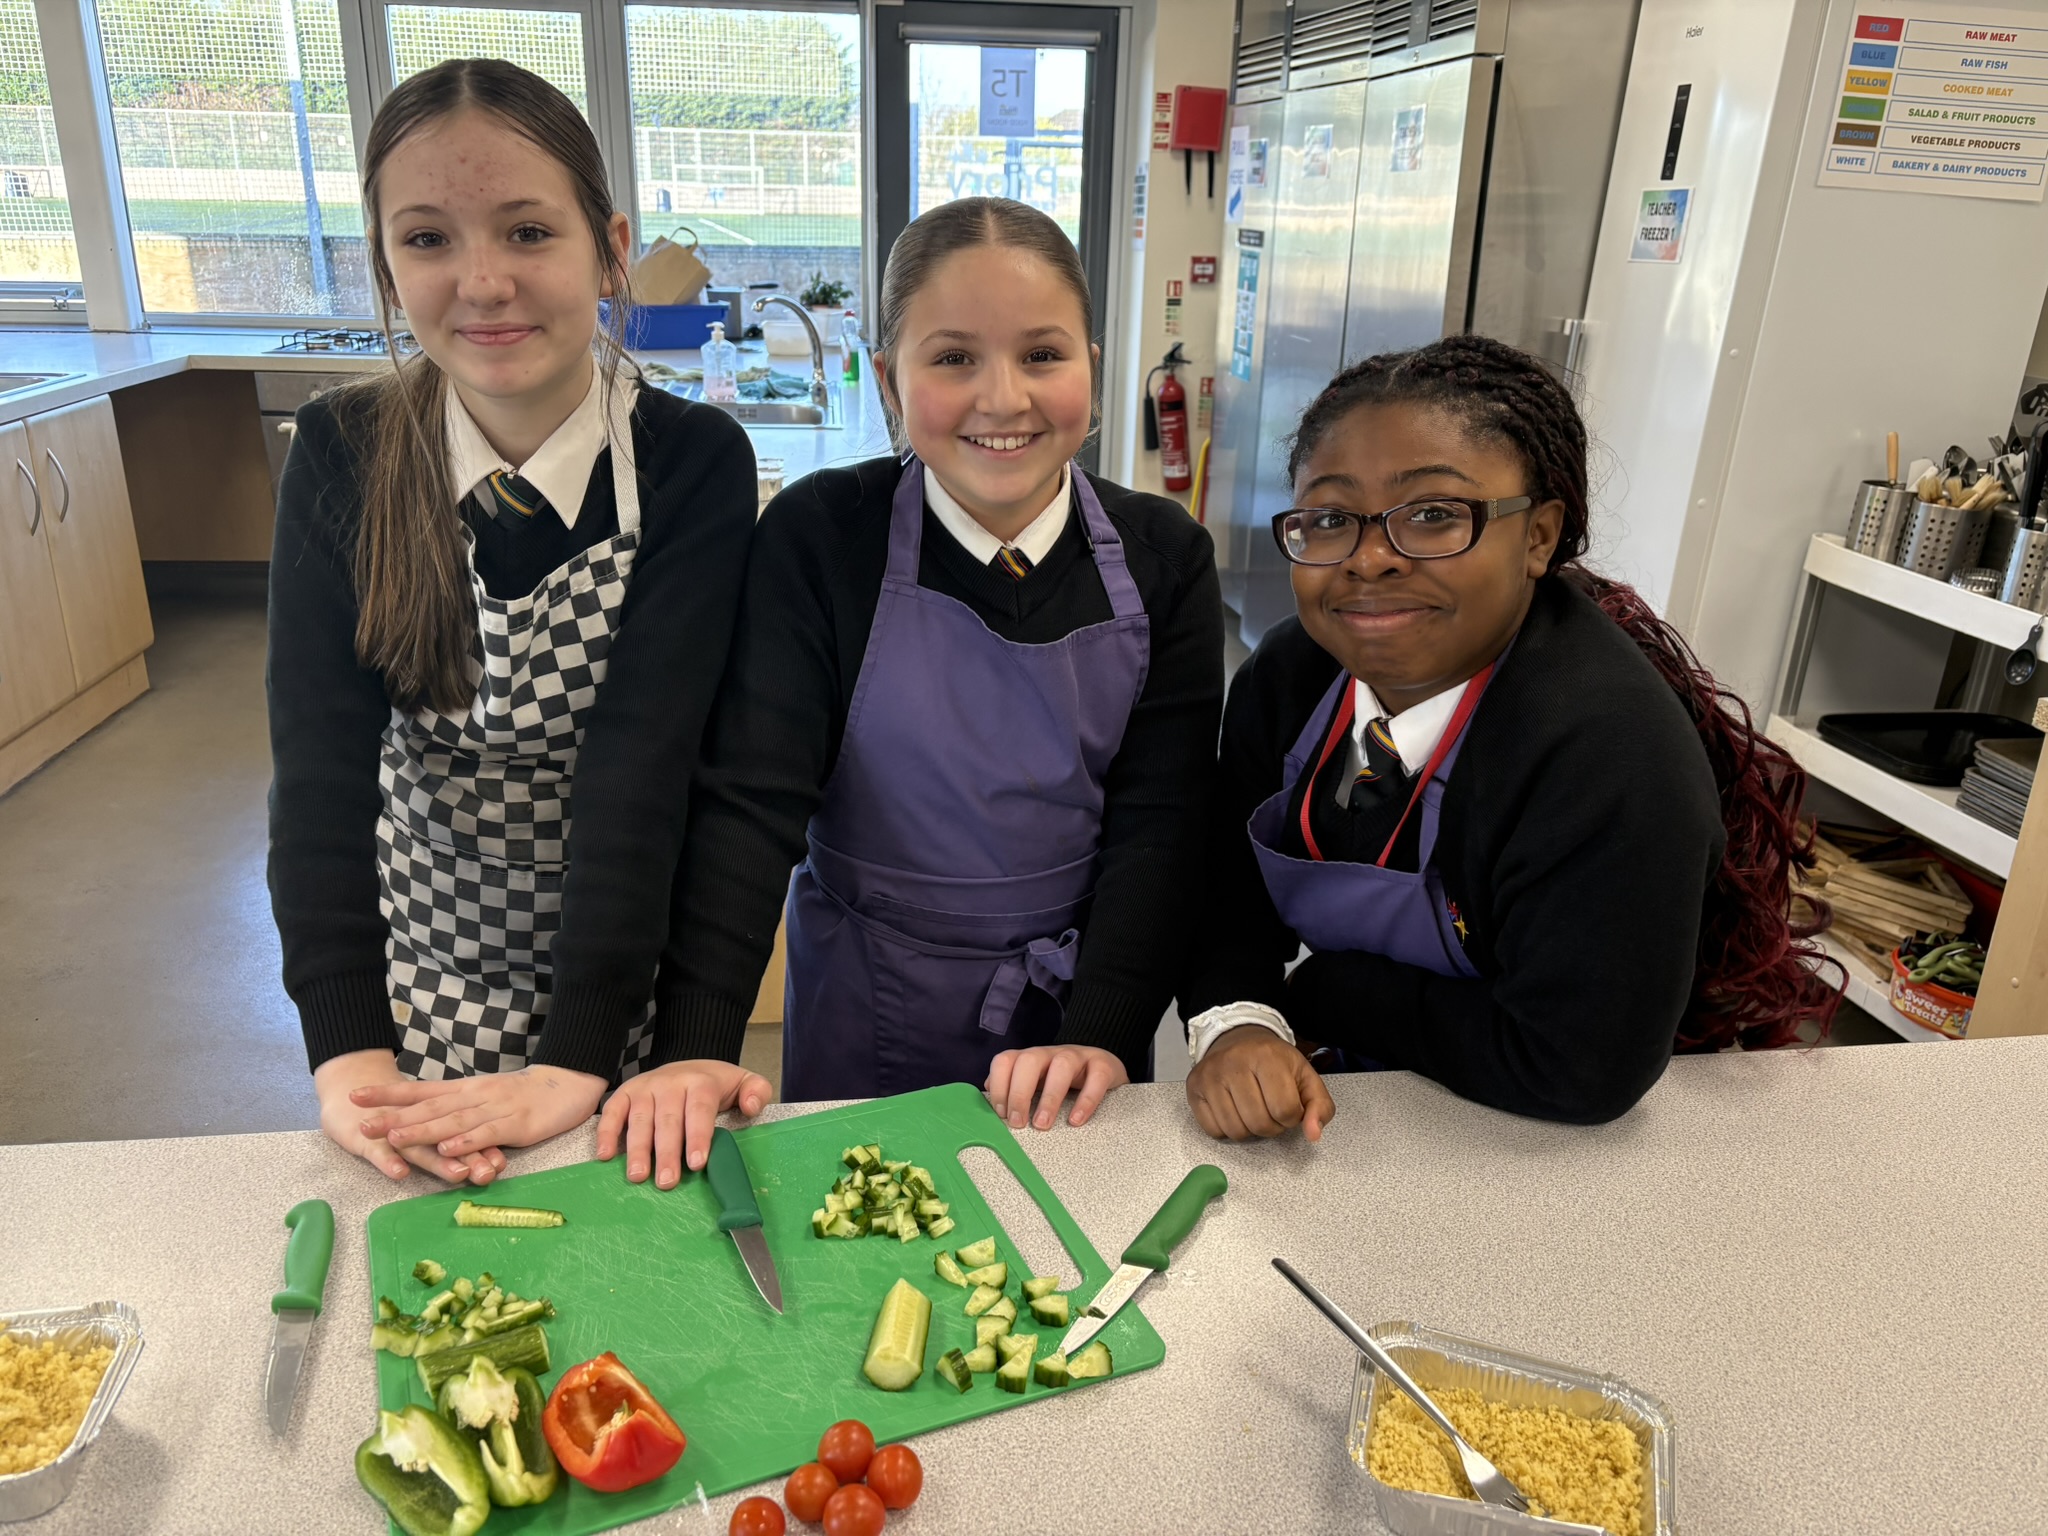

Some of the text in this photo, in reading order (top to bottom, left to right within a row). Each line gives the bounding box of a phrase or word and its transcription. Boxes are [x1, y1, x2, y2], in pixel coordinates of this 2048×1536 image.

[1685, 26, 1704, 39] Haier
[1869, 23, 1890, 33] RED
[1965, 30, 2017, 43] RAW MEAT
[1861, 50, 1886, 60] BLUE
[1961, 59, 2008, 69] RAW FISH
[1850, 77, 1888, 87] YELLOW
[1943, 84, 2014, 96] COOKED MEAT
[1908, 109, 2036, 125] SALAD & FRUIT PRODUCTS
[1839, 129, 1875, 140] BROWN
[1911, 135, 2021, 151] VEGETABLE PRODUCTS
[1836, 156, 1866, 166] WHITE
[1892, 160, 2027, 177] BAKERY & DAIRY PRODUCTS
[1647, 202, 1677, 216] TEACHER
[1640, 227, 1675, 241] FREEZER 1
[1905, 988, 1949, 1018] Sweet
[1905, 1001, 1944, 1026] Treats
